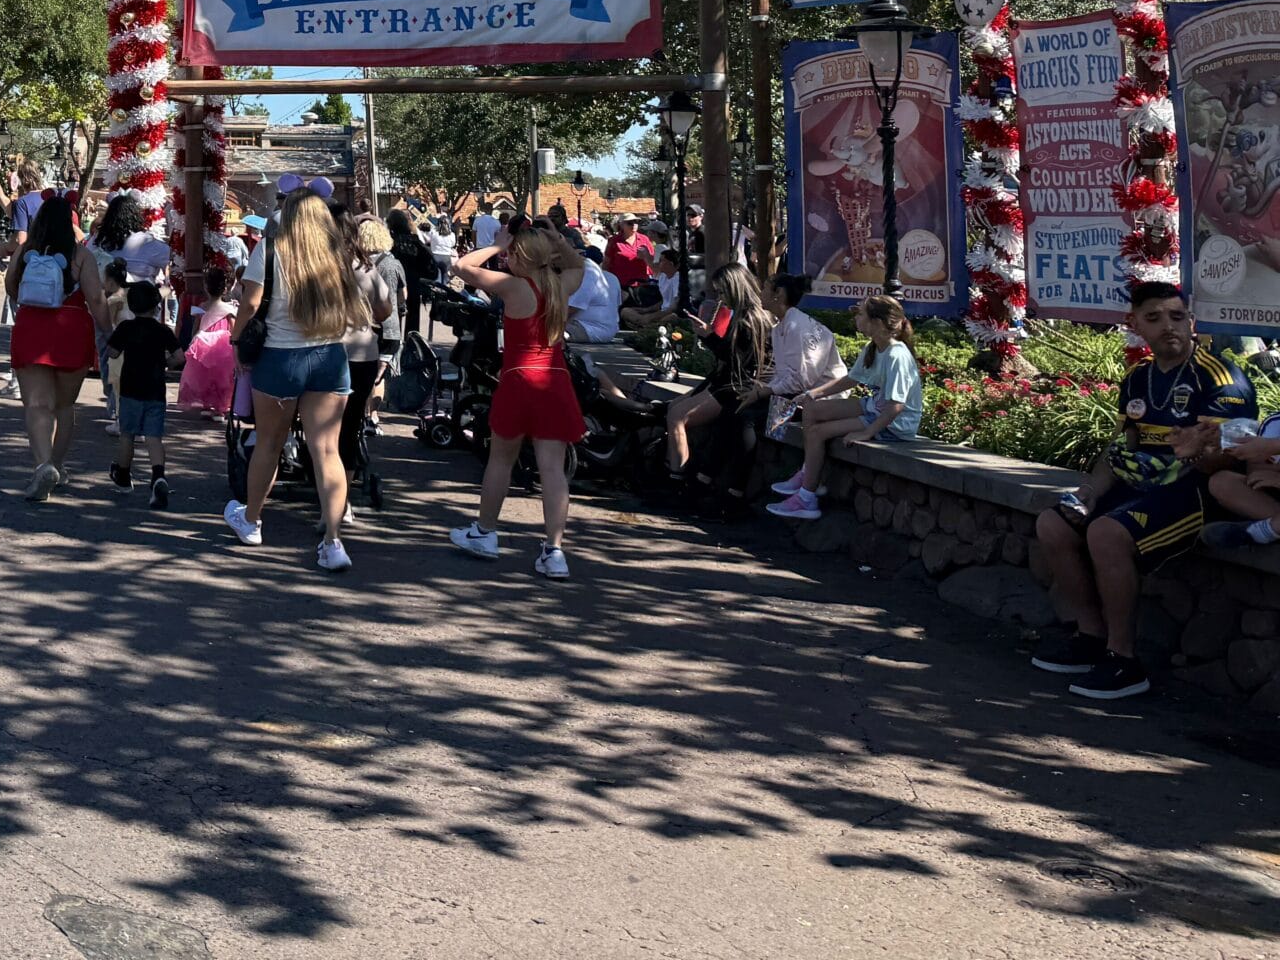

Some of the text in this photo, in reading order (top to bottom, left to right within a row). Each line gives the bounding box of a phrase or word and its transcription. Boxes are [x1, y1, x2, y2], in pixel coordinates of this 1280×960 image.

[1024, 28, 1111, 53] A WORLD OF
[1020, 54, 1119, 89] CIRCUS FUN
[836, 90, 863, 99] FAMOUS
[1047, 107, 1097, 118] FEATURING
[1025, 119, 1123, 152] ASTONISHING
[1059, 143, 1091, 160] ACTS
[1030, 165, 1120, 186] COUNTLESS
[1028, 188, 1125, 213] WONDER
[1035, 253, 1127, 282] FEATS
[830, 284, 944, 300] STORYBO CIRCUS
[1038, 285, 1063, 299] FOR
[1070, 283, 1103, 304] ALL
